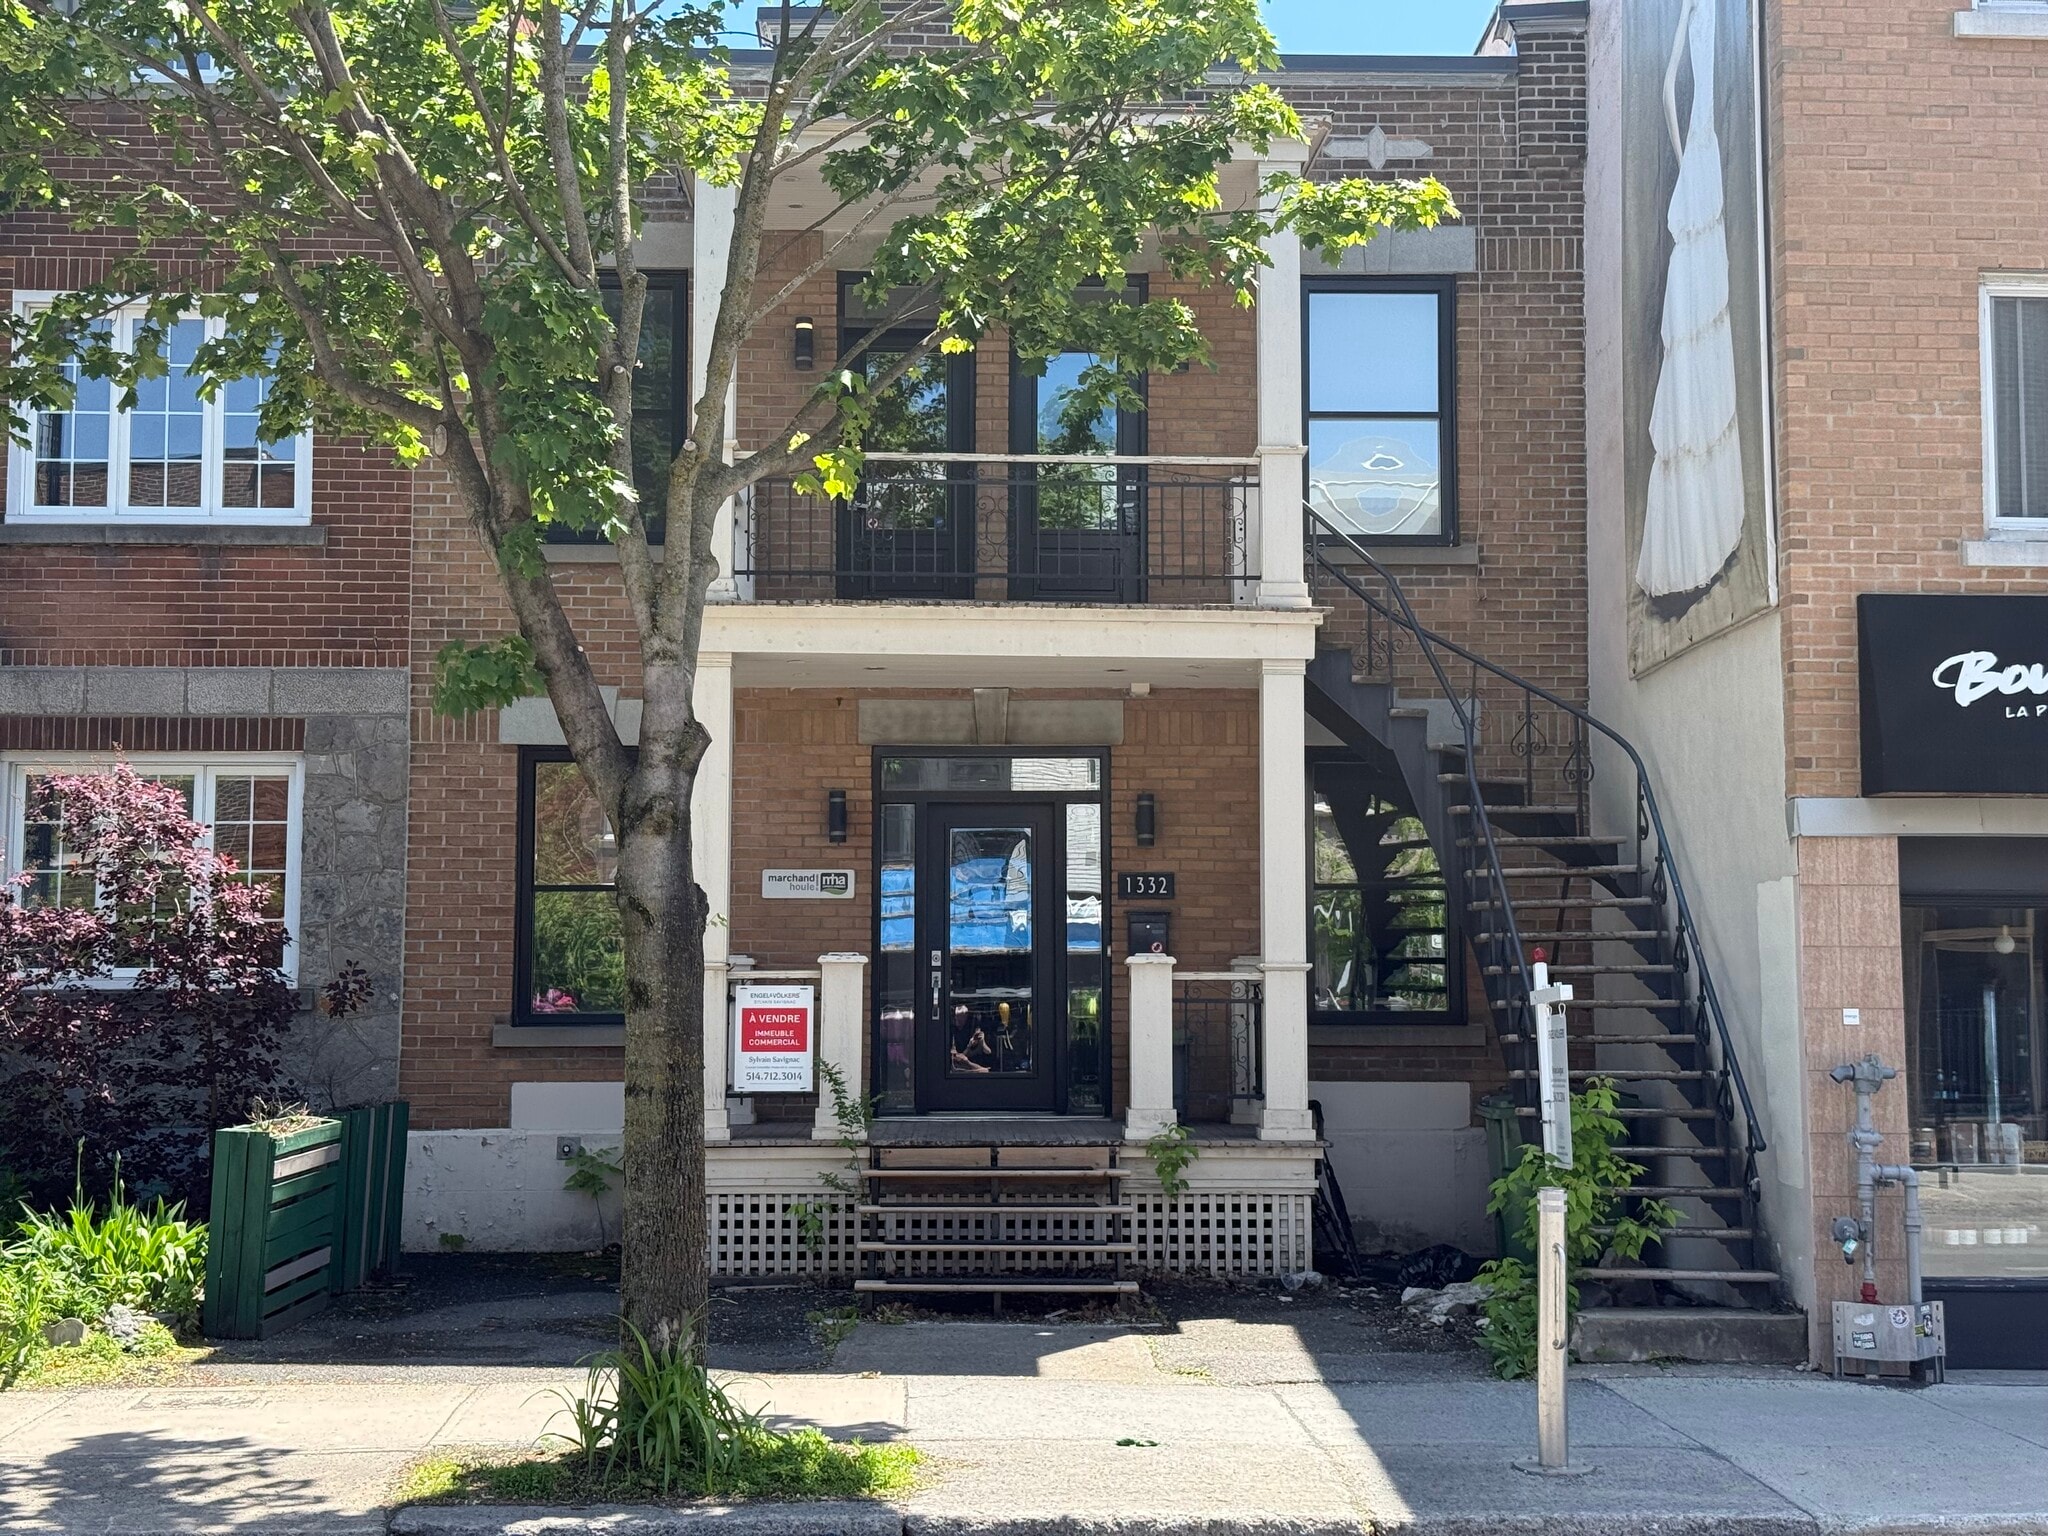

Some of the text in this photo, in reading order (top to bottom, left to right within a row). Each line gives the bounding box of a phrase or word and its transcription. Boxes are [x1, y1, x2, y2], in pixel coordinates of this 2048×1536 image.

[2005, 706, 2028, 718] LA
[768, 873, 815, 882] marchand
[789, 883, 815, 891] houle
[1126, 876, 1167, 894] 1332
[749, 1012, 801, 1023] À VENDRE
[748, 1038, 801, 1046] COMMERCIAL
[748, 1056, 800, 1064] Sylvain Savignac
[746, 1072, 802, 1080] 514.712.3014
